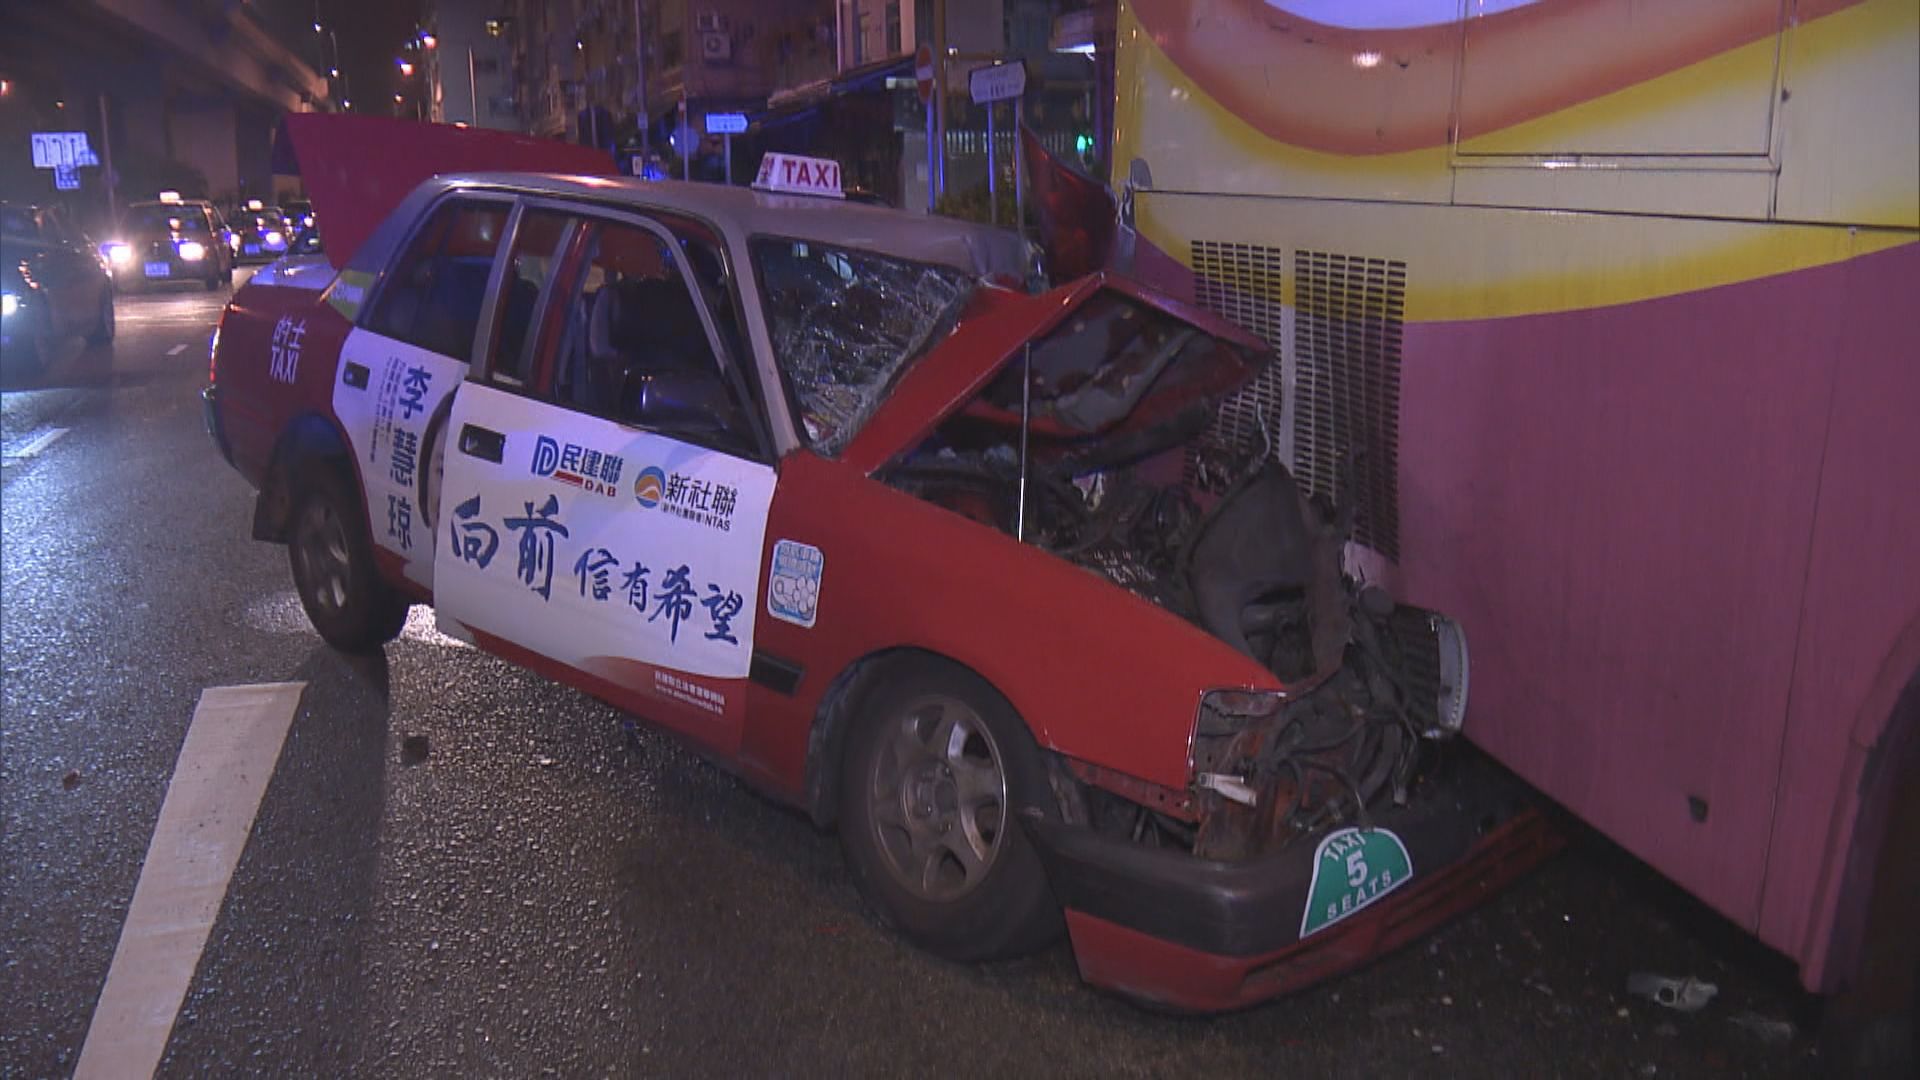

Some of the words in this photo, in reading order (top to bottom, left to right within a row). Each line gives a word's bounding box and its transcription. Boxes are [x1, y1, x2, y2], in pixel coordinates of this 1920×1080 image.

[783, 160, 838, 188] TAXI
[272, 315, 306, 349] 的士
[270, 346, 301, 384] TAXI
[561, 443, 624, 485] 民建聯
[584, 480, 616, 497] DAB
[665, 472, 738, 518] 新社聯
[705, 513, 731, 531] NTAS
[450, 494, 570, 602] 向前
[573, 547, 744, 645] 信有希望
[1324, 833, 1366, 861] TAXI
[1346, 848, 1369, 888] 5
[1326, 868, 1392, 920] SEATS
